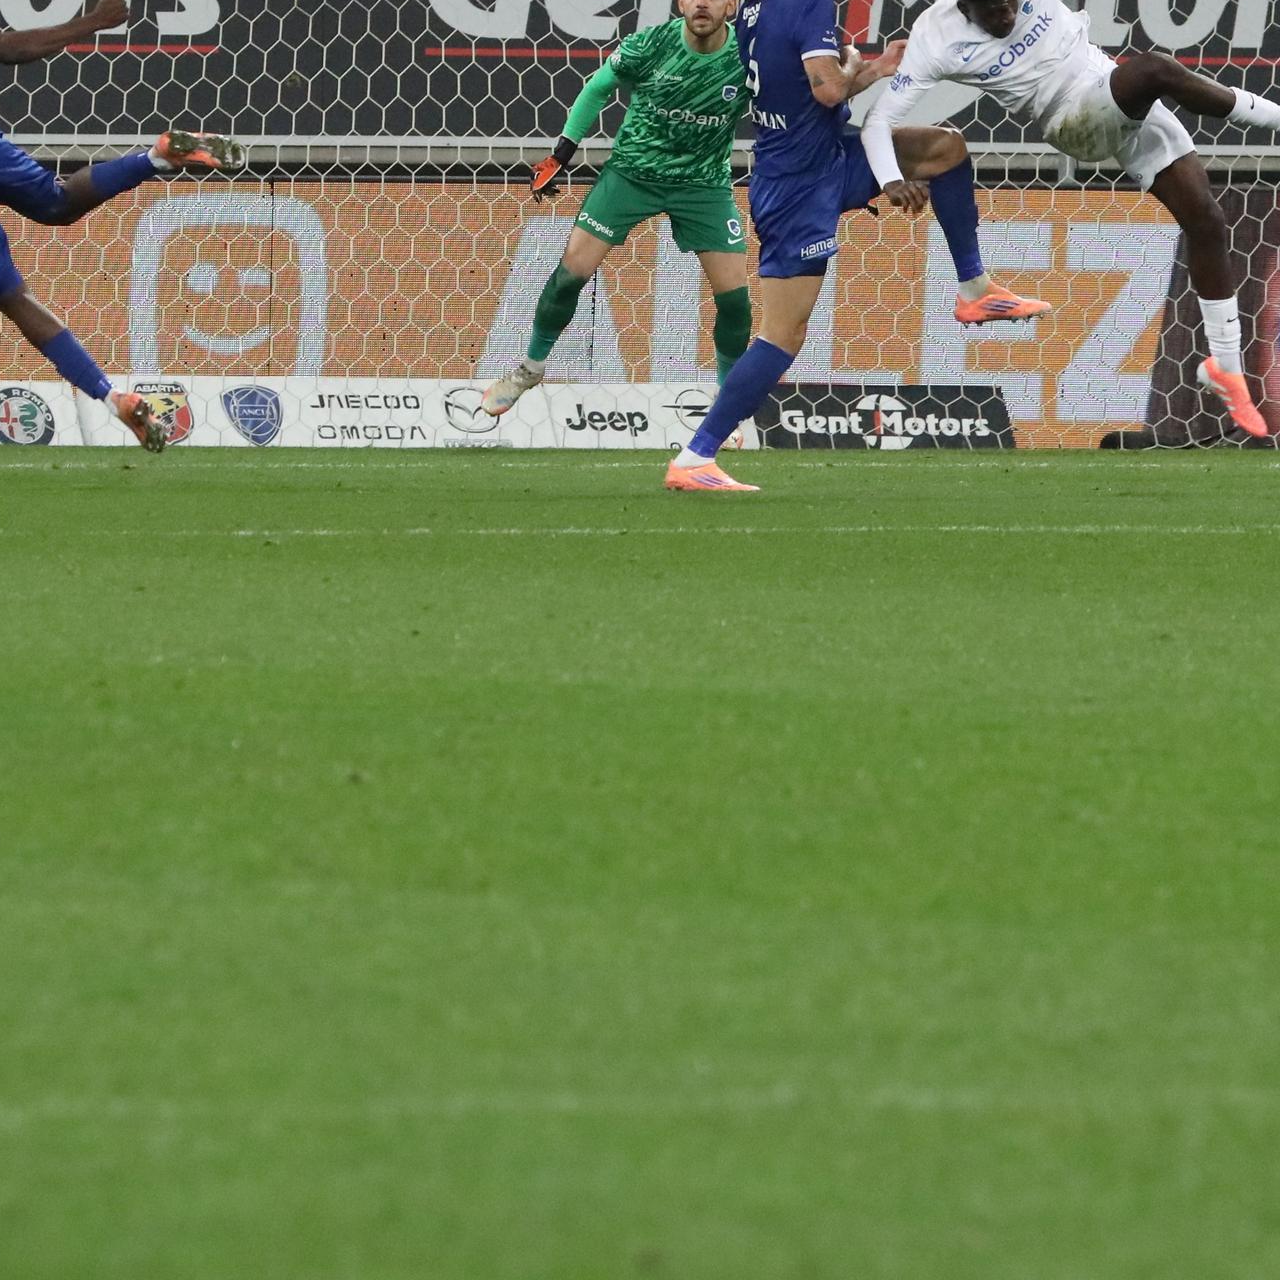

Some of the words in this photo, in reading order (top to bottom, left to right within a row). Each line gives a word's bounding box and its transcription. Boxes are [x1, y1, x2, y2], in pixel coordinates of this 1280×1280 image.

[475, 219, 1184, 422] ALEZ
[135, 383, 183, 394] ABARTH
[11, 389, 54, 423] ROMEO
[566, 403, 650, 437] Jeep
[779, 410, 864, 434] Gent
[878, 412, 991, 437] Motors
